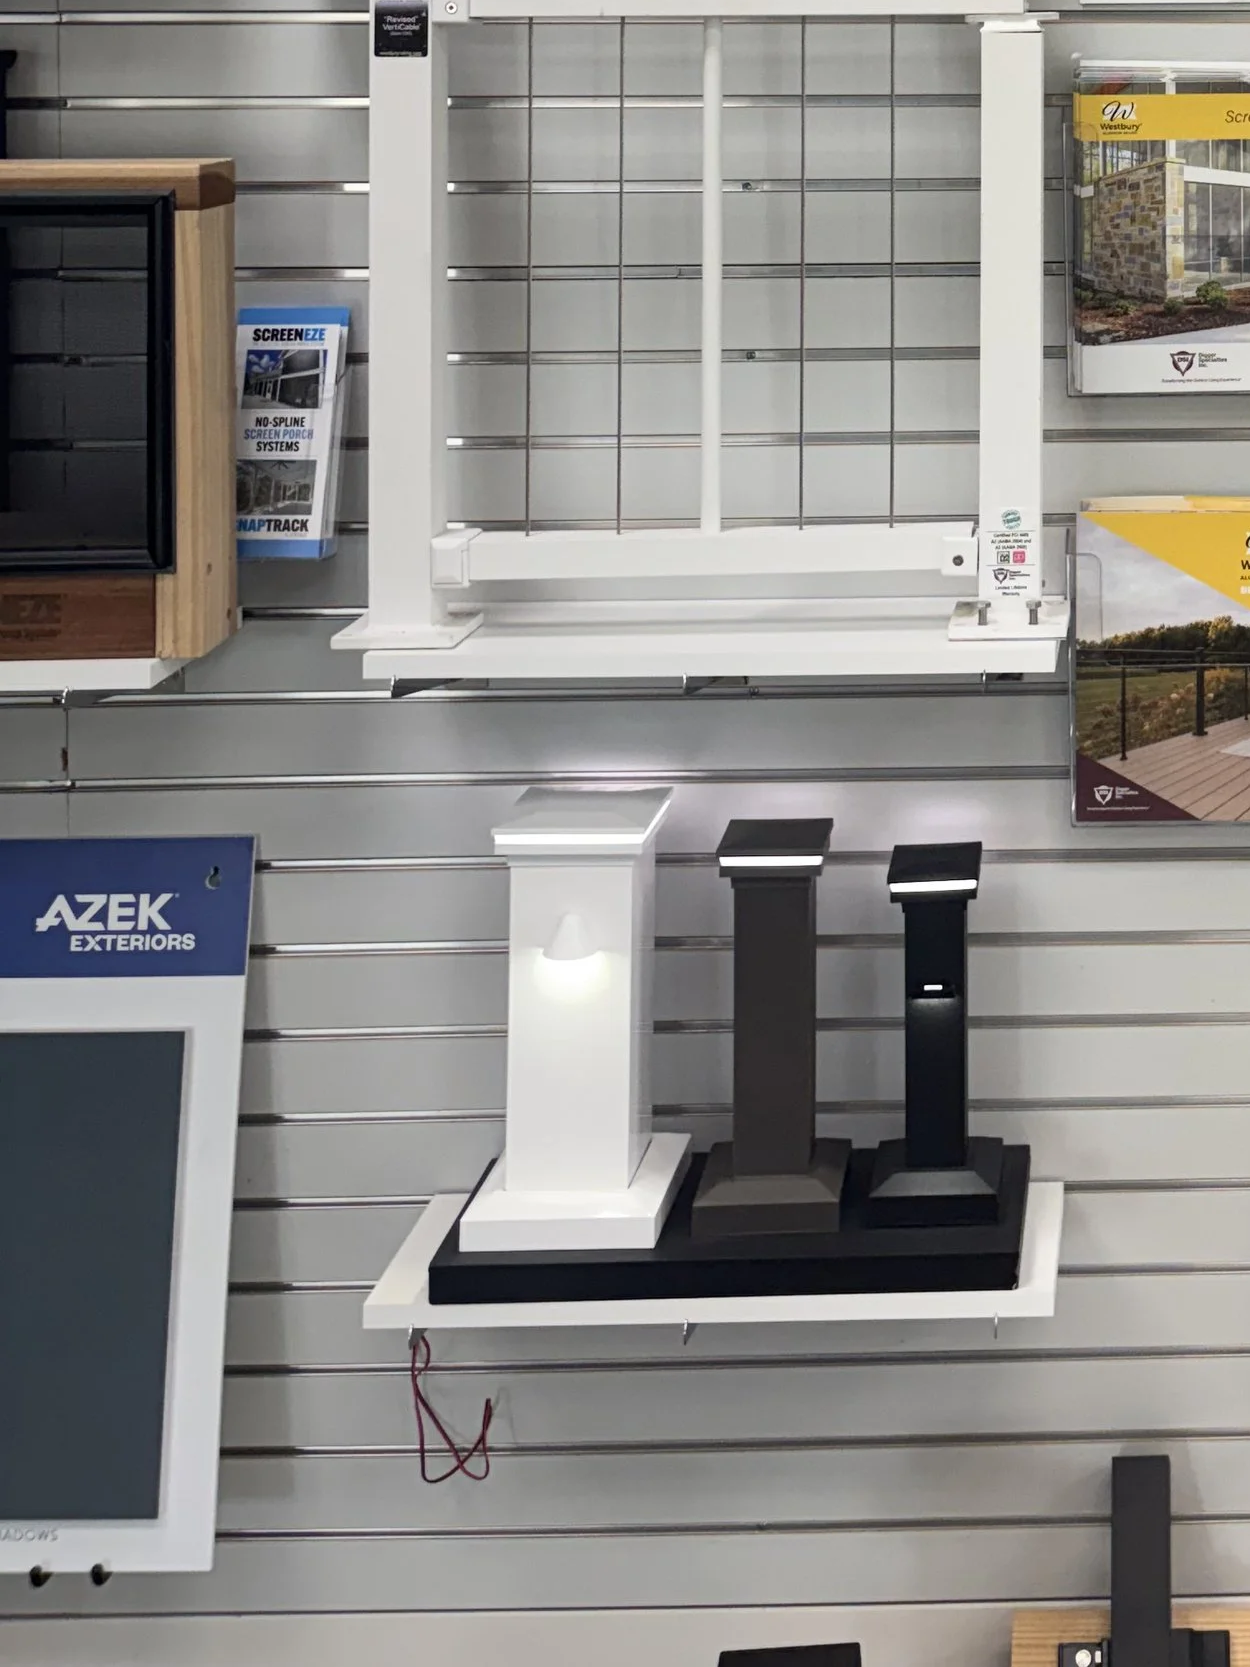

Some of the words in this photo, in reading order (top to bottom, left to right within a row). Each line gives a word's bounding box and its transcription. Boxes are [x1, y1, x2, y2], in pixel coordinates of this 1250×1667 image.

[1100, 123, 1140, 131] Westbury
[252, 328, 326, 342] SCREENEZE
[255, 417, 306, 428] NO-SPLINE
[244, 428, 280, 440] SCREEN
[283, 428, 314, 440] PORCH
[256, 441, 300, 452] SYSTEMS
[236, 518, 309, 532] NAPTRACK
[35, 893, 174, 932] AZEK
[70, 933, 196, 952] EXTERIORS
